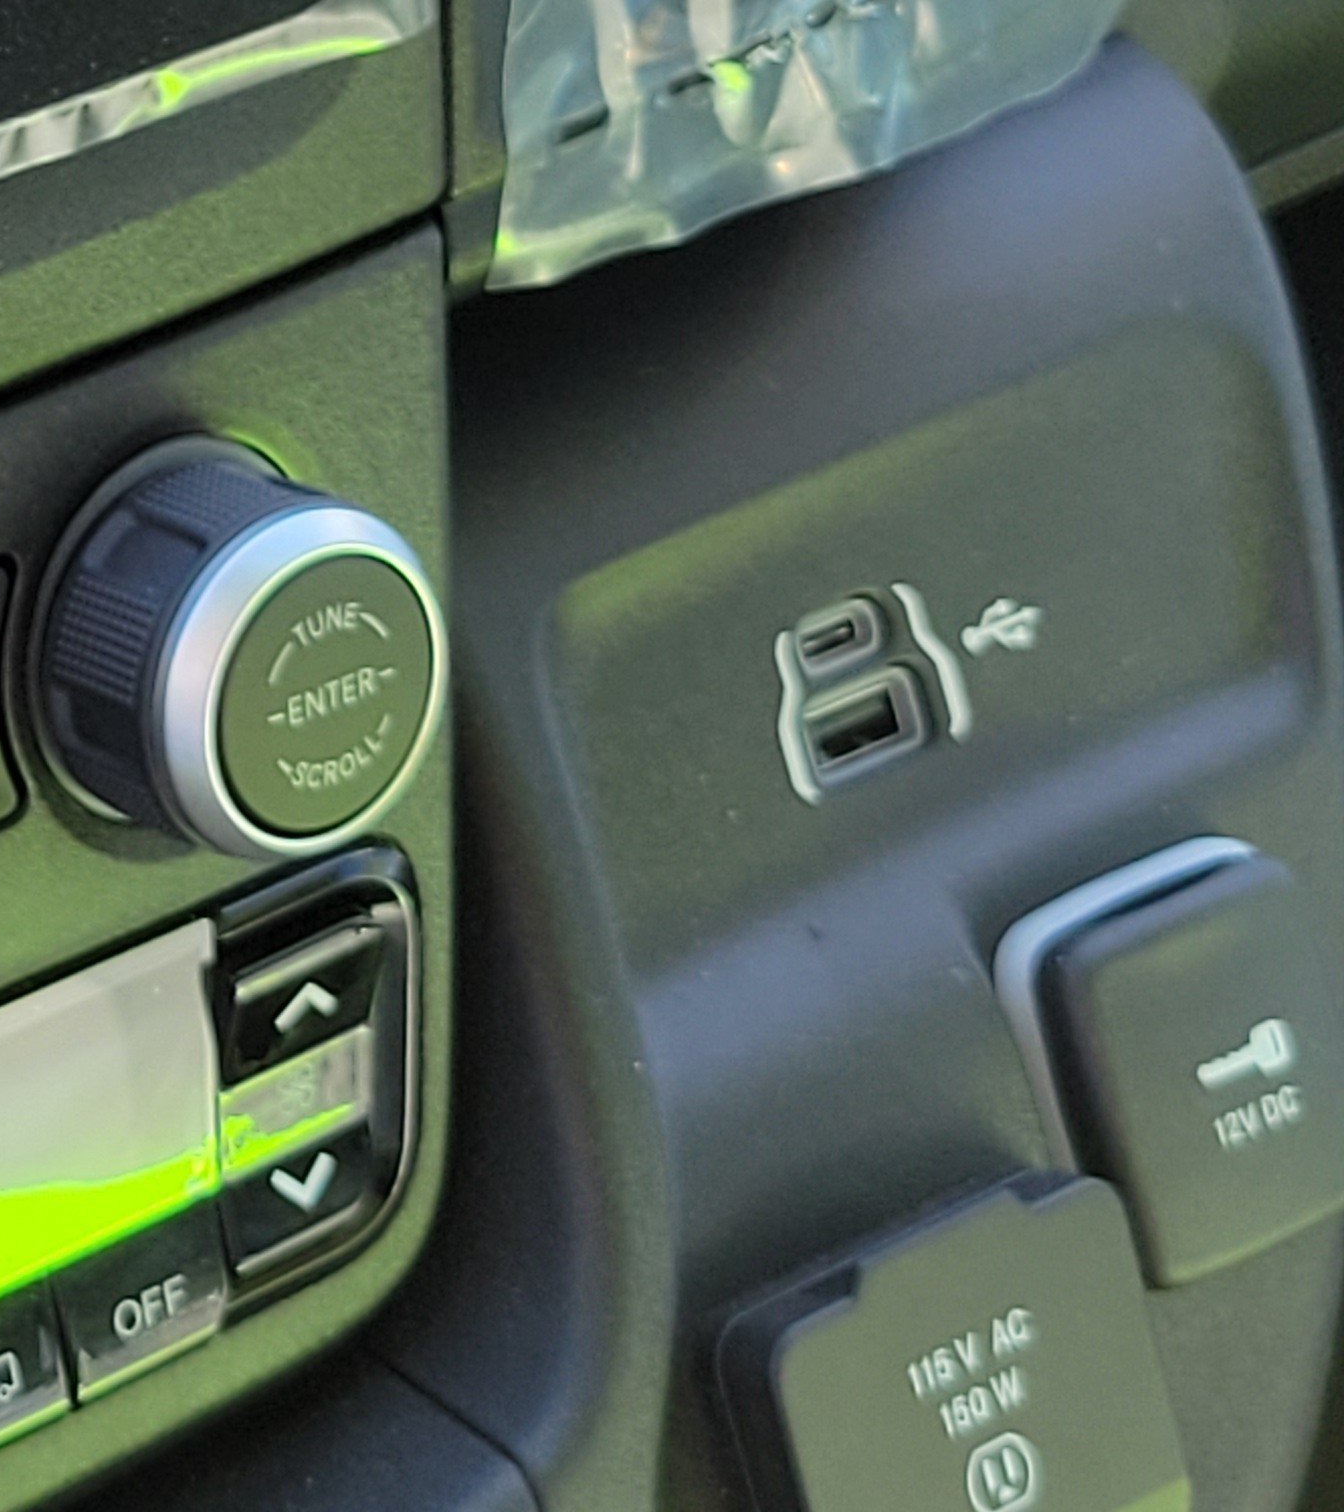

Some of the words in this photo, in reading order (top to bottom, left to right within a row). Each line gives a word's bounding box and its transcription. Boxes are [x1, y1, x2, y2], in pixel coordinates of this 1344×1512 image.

[293, 601, 360, 648] TUNE
[290, 733, 384, 789] SCROLL
[1213, 1101, 1259, 1149] 12V
[1259, 1085, 1303, 1128] DC
[113, 1275, 187, 1340] OFF
[992, 1307, 1033, 1358] AC
[989, 1365, 1026, 1413] W
